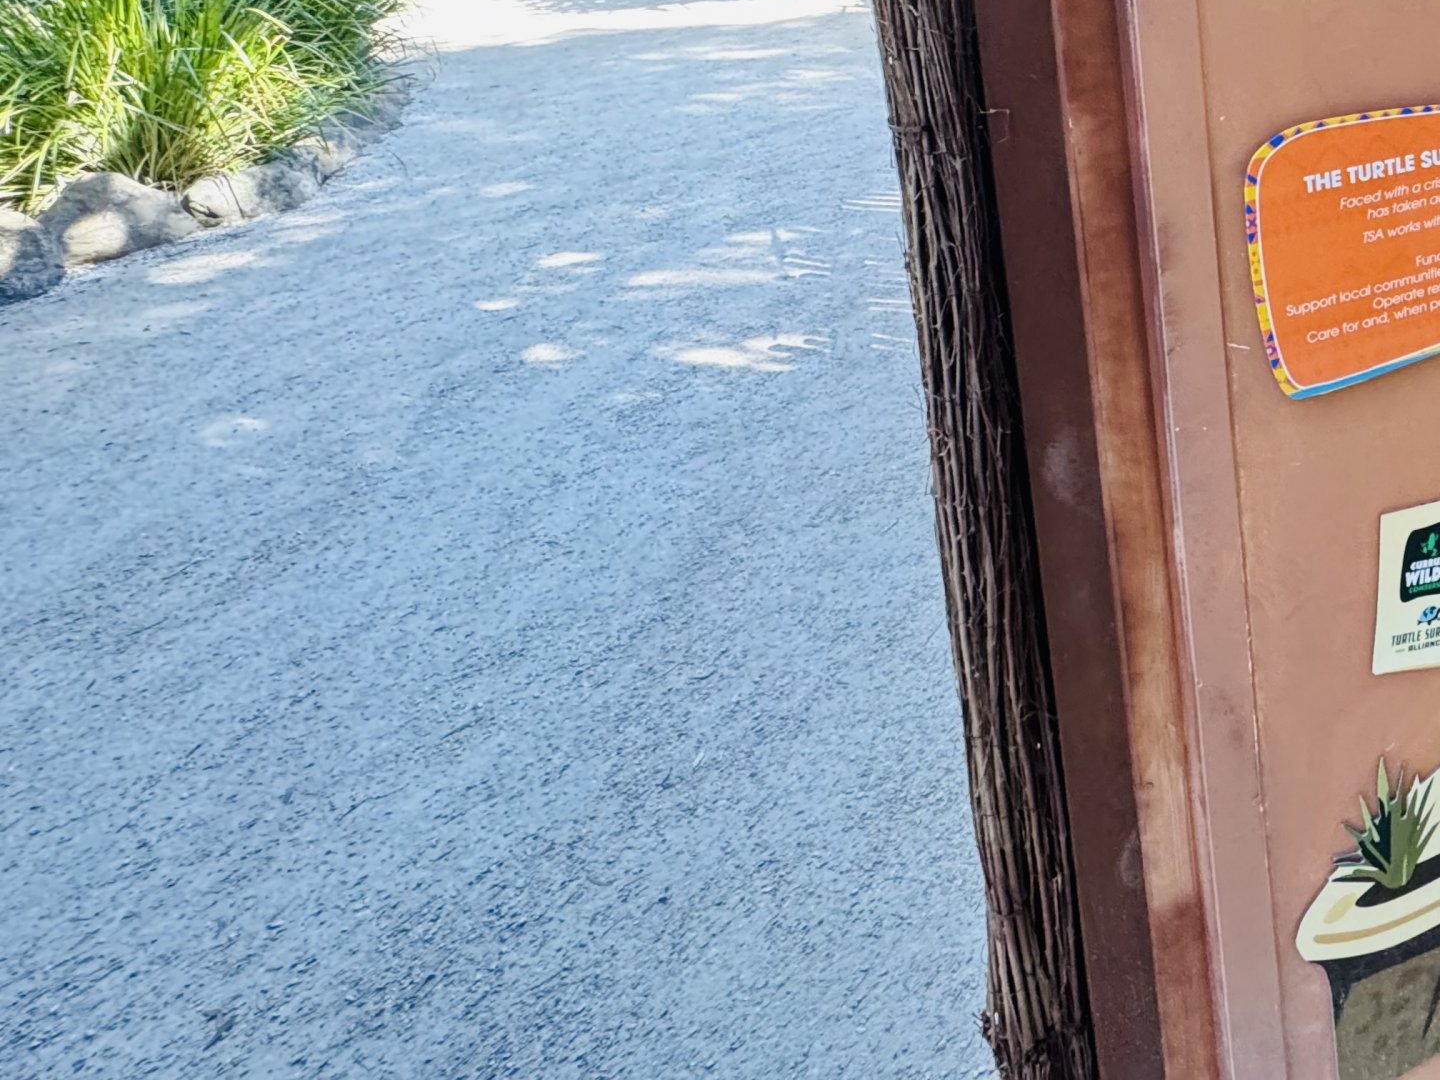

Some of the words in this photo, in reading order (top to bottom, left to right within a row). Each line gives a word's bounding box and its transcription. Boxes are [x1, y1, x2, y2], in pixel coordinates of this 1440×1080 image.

[1303, 168, 1341, 194] THE
[1347, 153, 1414, 185] TURTLE
[1340, 189, 1380, 209] Faced
[1384, 183, 1408, 200] with
[1411, 184, 1420, 194] a
[1367, 206, 1389, 219] has
[1392, 198, 1426, 214] taken
[1363, 227, 1383, 244] TSA
[1387, 220, 1420, 238] works
[1286, 291, 1336, 315] Support
[1340, 282, 1370, 302] local
[1373, 286, 1424, 309] Operate
[1307, 326, 1339, 342] Care
[1342, 320, 1358, 333] for
[1393, 302, 1426, 319] when
[1392, 630, 1421, 647] TURTLE
